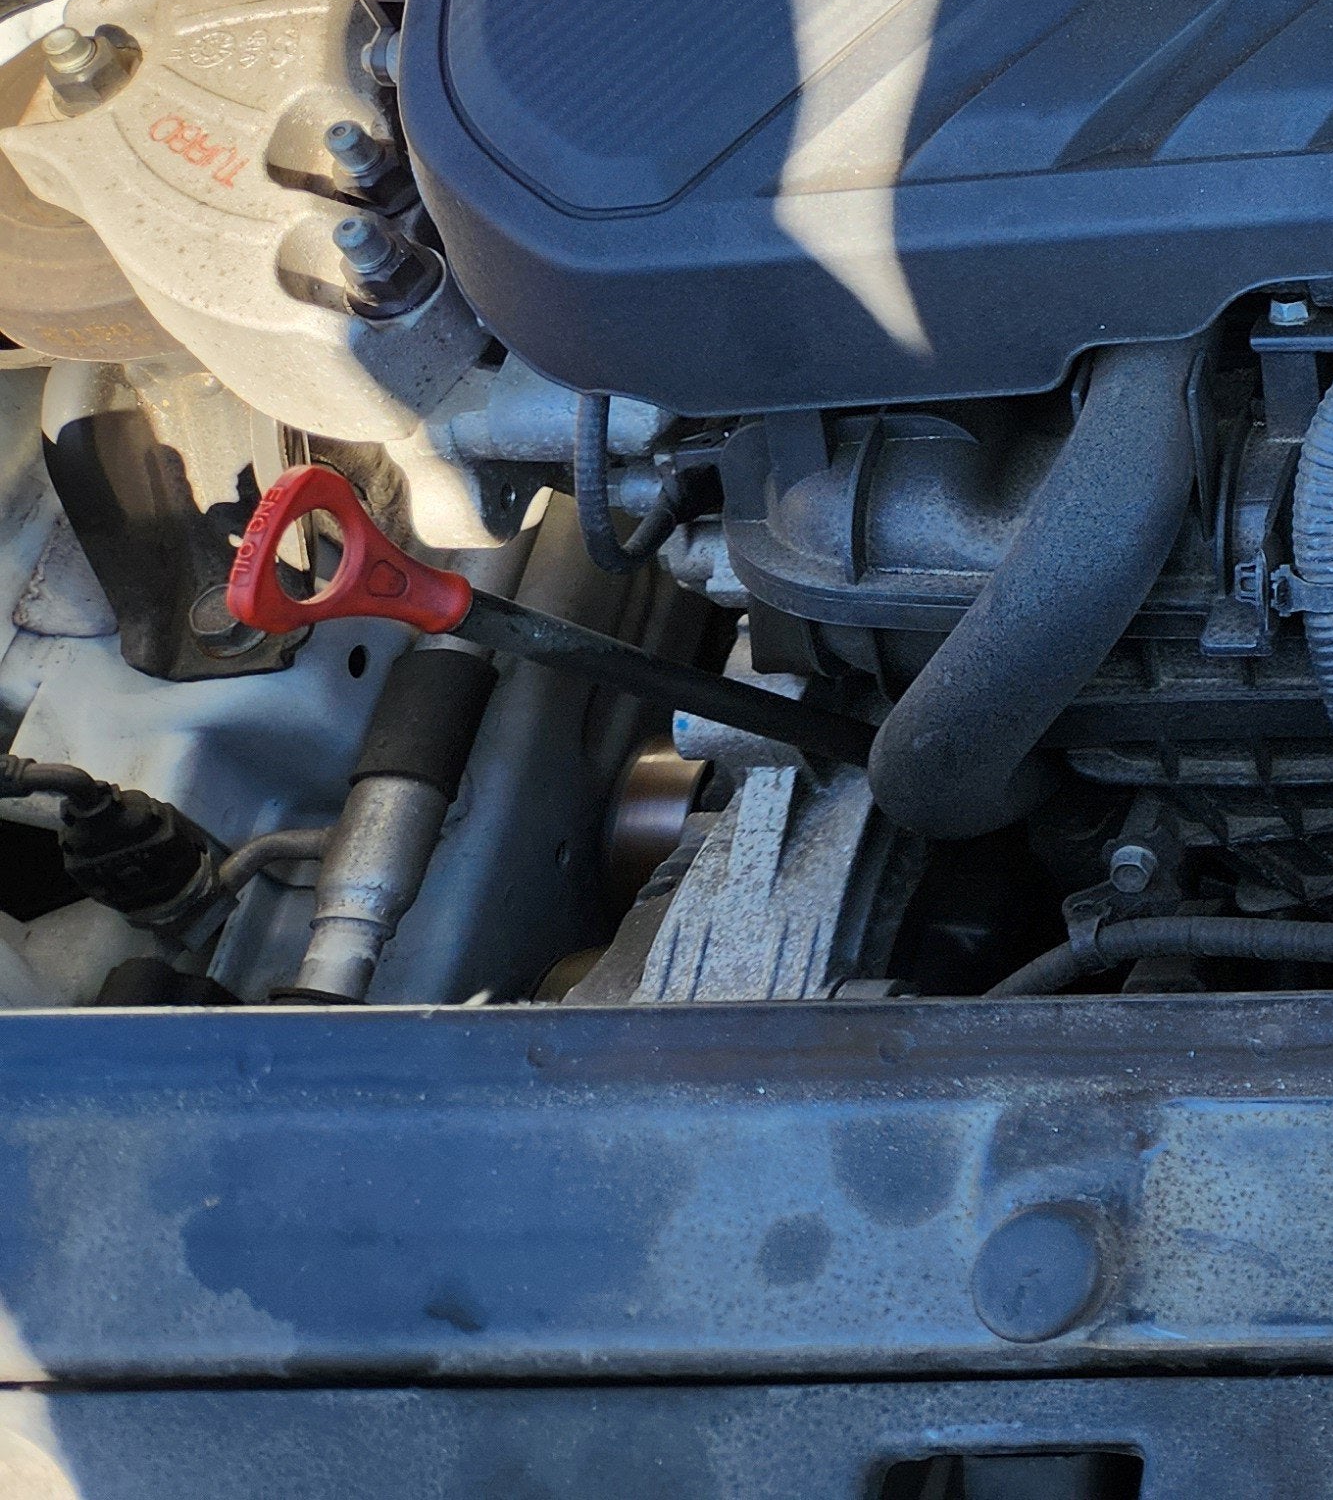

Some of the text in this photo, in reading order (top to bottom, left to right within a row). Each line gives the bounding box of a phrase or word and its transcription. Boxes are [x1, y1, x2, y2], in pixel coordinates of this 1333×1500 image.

[149, 115, 250, 190] TURBO
[230, 486, 283, 586] ENG OIL
